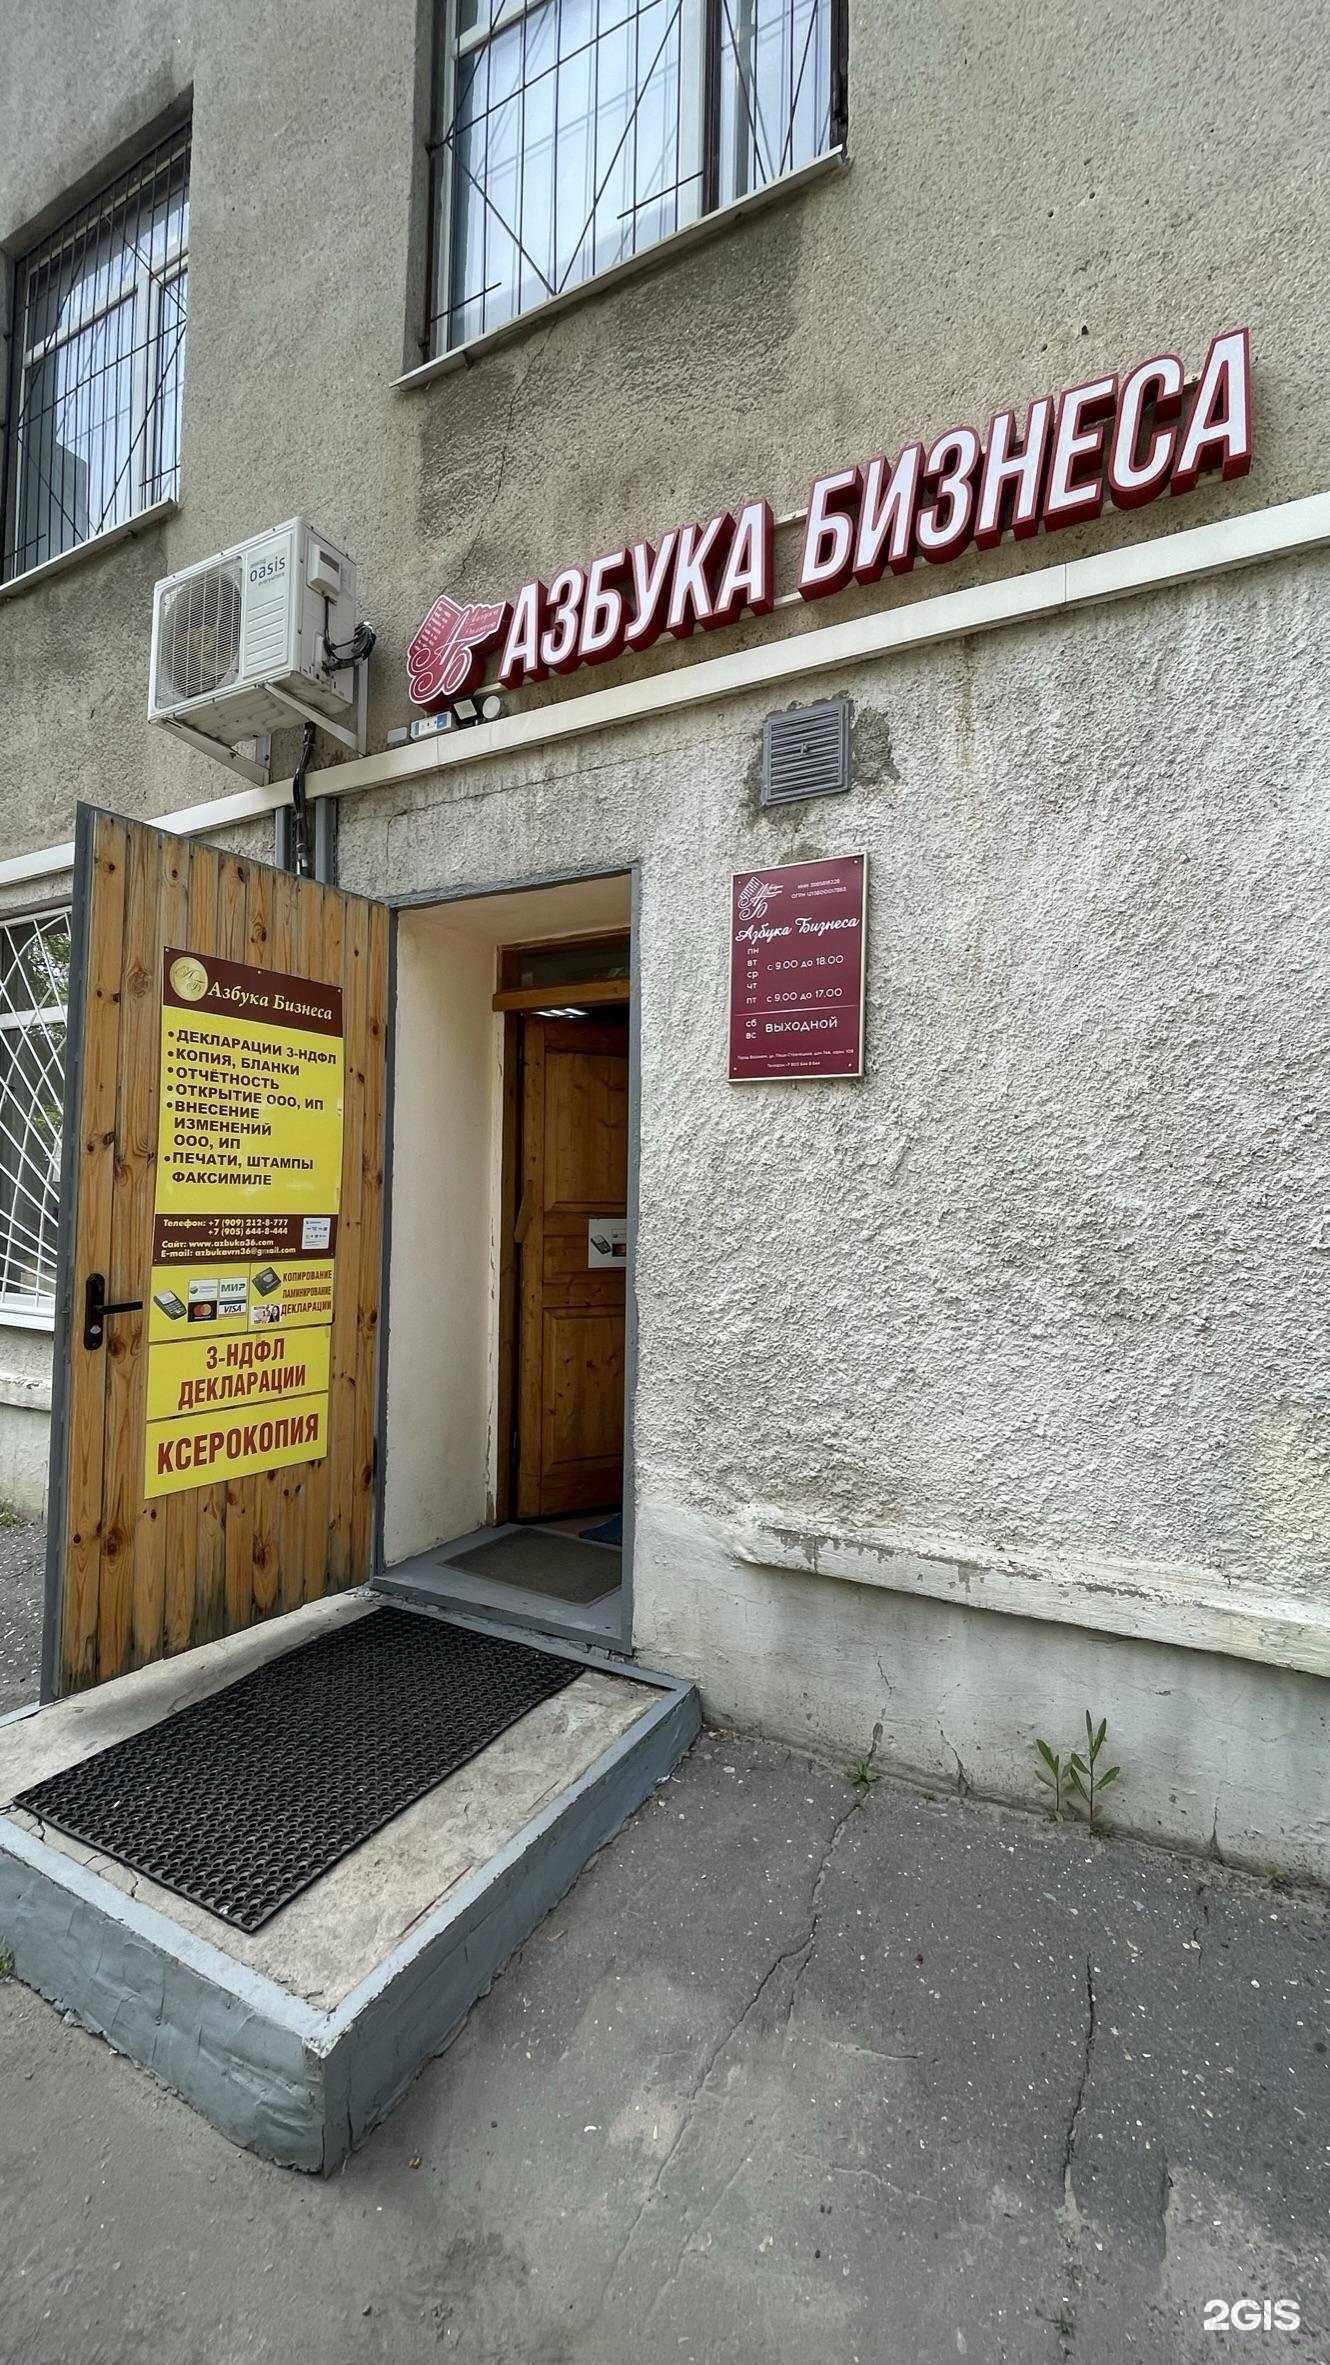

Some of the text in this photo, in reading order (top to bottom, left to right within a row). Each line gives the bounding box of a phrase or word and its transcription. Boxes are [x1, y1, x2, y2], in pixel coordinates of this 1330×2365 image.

[499, 328, 1252, 684] АЗБУКА БИЗНЕСА
[250, 556, 286, 582] oasis
[735, 917, 860, 945] Азбука Бизнеса
[775, 960, 799, 970] 9.00
[816, 954, 844, 966] 18.00
[207, 981, 333, 1021] Азбука Бизнеса
[774, 991, 798, 1002] 9.00
[815, 987, 843, 999] 17.00
[176, 1029, 337, 1065] ДЕКЛАРАЦИИ 3-НДФЛ
[176, 1048, 300, 1076] КОПИЯ, БЛАНКИ
[176, 1066, 280, 1090] ОТЧЁТНОСТЬ
[175, 1083, 324, 1111] ОТКРЫТИЕ ООО, ИП
[174, 1100, 260, 1119] ВНЕСЕНИЕ
[174, 1117, 272, 1136] ИЗМЕНЕНИЙ
[173, 1134, 241, 1150] ООО, ИП
[172, 1152, 314, 1170] ПЕЧАТИ, ШТАМПЫ
[172, 1171, 272, 1186] ФАКСИМИЛЕ
[163, 1218, 289, 1229] Телефон: +7 (909) 212-8-777
[208, 1227, 289, 1237] +7 (905) 644-8-444
[161, 1238, 275, 1249] Сайт: www.azbuka36.com
[161, 1249, 194, 1258] E-mail:
[282, 1269, 333, 1282] КОПИРОВАНИЕ
[221, 1283, 246, 1293] МИР
[223, 1304, 242, 1314] VISA
[280, 1300, 332, 1316] ДЕКЛАРАЦИИ
[206, 1337, 285, 1370] 3-НДФЛ
[178, 1364, 306, 1412] ДЕКЛАРАЦИИ
[157, 1413, 320, 1476] КСЕРОКОПИЯ
